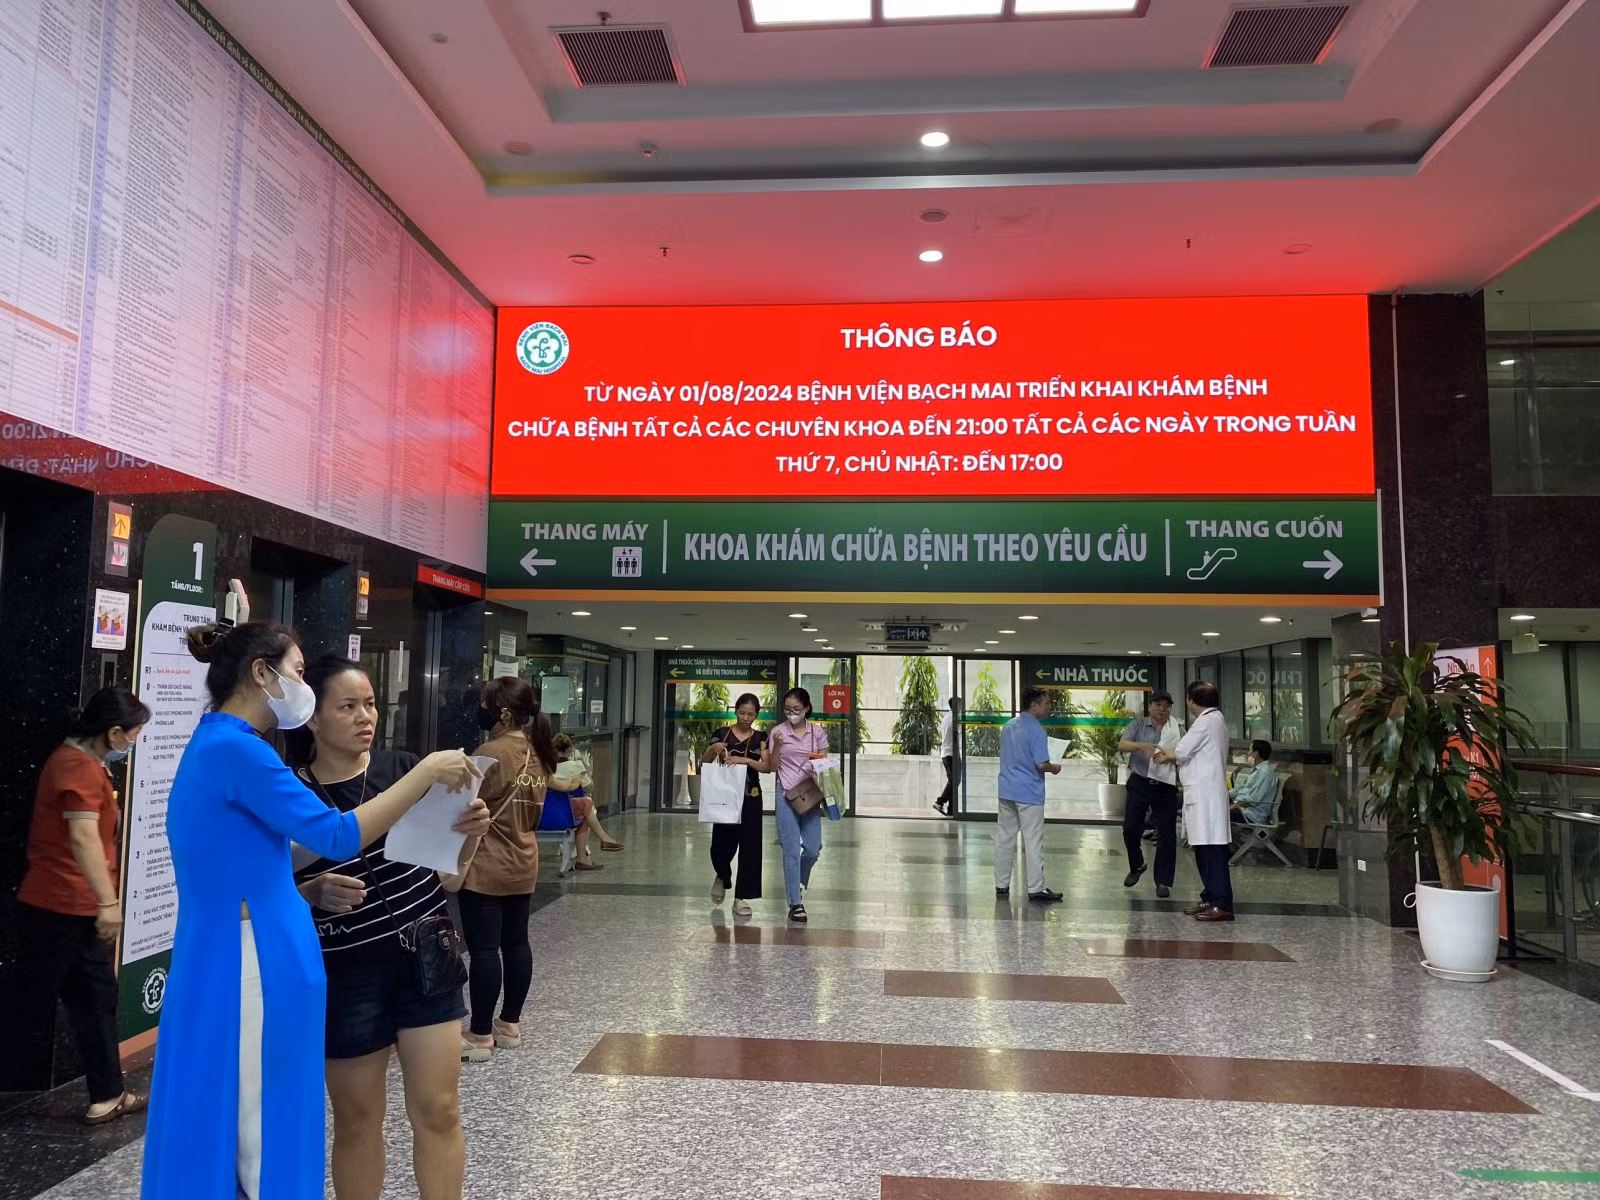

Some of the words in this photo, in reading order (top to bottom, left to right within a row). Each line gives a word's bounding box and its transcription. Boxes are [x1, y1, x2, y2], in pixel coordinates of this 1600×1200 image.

[841, 322, 934, 349] THÔNG
[941, 320, 997, 347] BÁO
[584, 381, 615, 402] TỪ
[618, 381, 675, 402] NGÀY
[680, 381, 793, 405] 01/08/2024
[798, 380, 851, 404] BỆNH
[856, 379, 903, 404] VIỆN
[908, 383, 966, 404] BẠCH
[972, 383, 1012, 399] MAI
[1016, 375, 1075, 398] TRIỂN
[1081, 381, 1132, 398] KHAI
[1138, 375, 1204, 397] KHÁM
[1210, 374, 1268, 400] BỆNH
[508, 416, 570, 437] CHỮA
[575, 416, 628, 441] BỆNH
[632, 415, 669, 437] TẤT
[673, 415, 703, 437] CẢ
[706, 416, 751, 437] CÁC
[756, 416, 840, 437] CHUYÊN
[844, 419, 904, 437] KHOA
[908, 414, 952, 436] ĐẾN
[956, 418, 1008, 435] 21:00
[1012, 412, 1052, 435] TẤT
[1056, 412, 1089, 434] CẢ
[1092, 412, 1141, 434] CÁC
[1146, 411, 1208, 433] NGÀY
[1213, 415, 1291, 433] TRONG
[1295, 410, 1356, 432] TUẦN
[776, 451, 821, 472] THỨ
[825, 455, 841, 475] 7,
[845, 450, 891, 473] CHỦ
[896, 451, 959, 476] NHẬT:
[962, 449, 1006, 472] ĐẾN
[1010, 454, 1063, 471] 17:00
[521, 523, 597, 540] THANG
[602, 520, 649, 540] MÁY
[1186, 520, 1269, 538] THANG
[1275, 514, 1343, 538] CUỐN
[684, 533, 750, 561] KHOA
[756, 528, 825, 561] KHÁM
[831, 526, 898, 562] CHỮA
[903, 527, 968, 570] BỆNH
[973, 533, 1039, 562] THEO
[1044, 527, 1091, 562] YÊU
[1097, 523, 1147, 562] CẦU
[192, 542, 204, 581] 1
[1054, 664, 1089, 682] NHÀ
[1090, 664, 1148, 683] THUỐC
